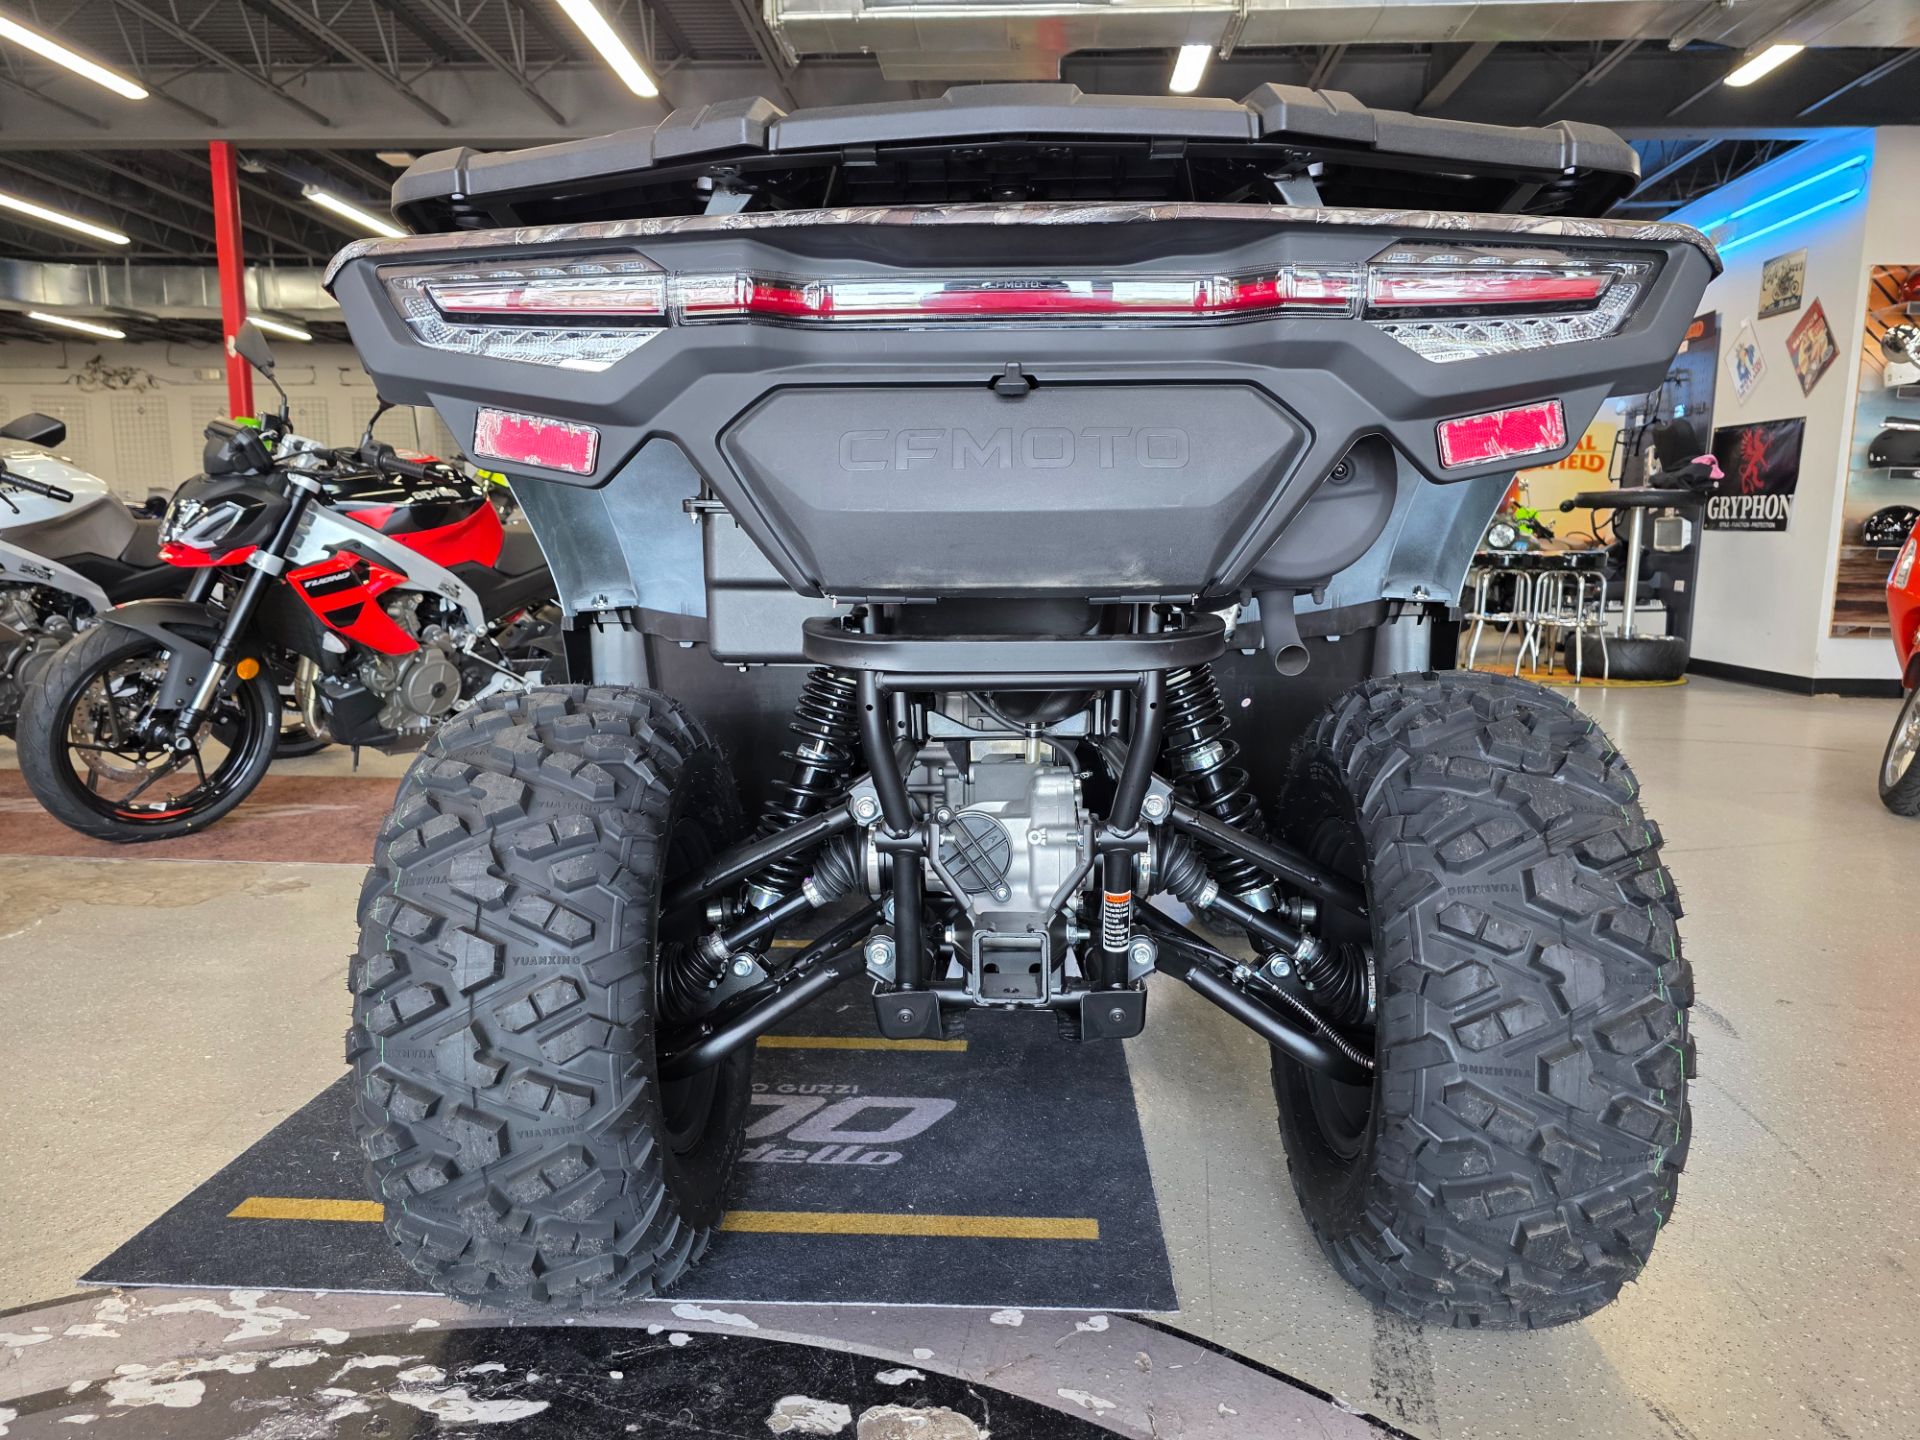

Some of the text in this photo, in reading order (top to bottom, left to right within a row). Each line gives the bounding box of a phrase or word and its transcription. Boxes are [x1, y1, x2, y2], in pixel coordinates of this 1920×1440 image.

[838, 427, 1191, 471] CFMOTO
[1707, 494, 1794, 520] GRYPHON
[1447, 883, 1519, 896] YUANXING
[512, 955, 581, 966] YUANXING
[1458, 1063, 1532, 1078] YUANXING
[777, 1083, 859, 1094] GUZZI
